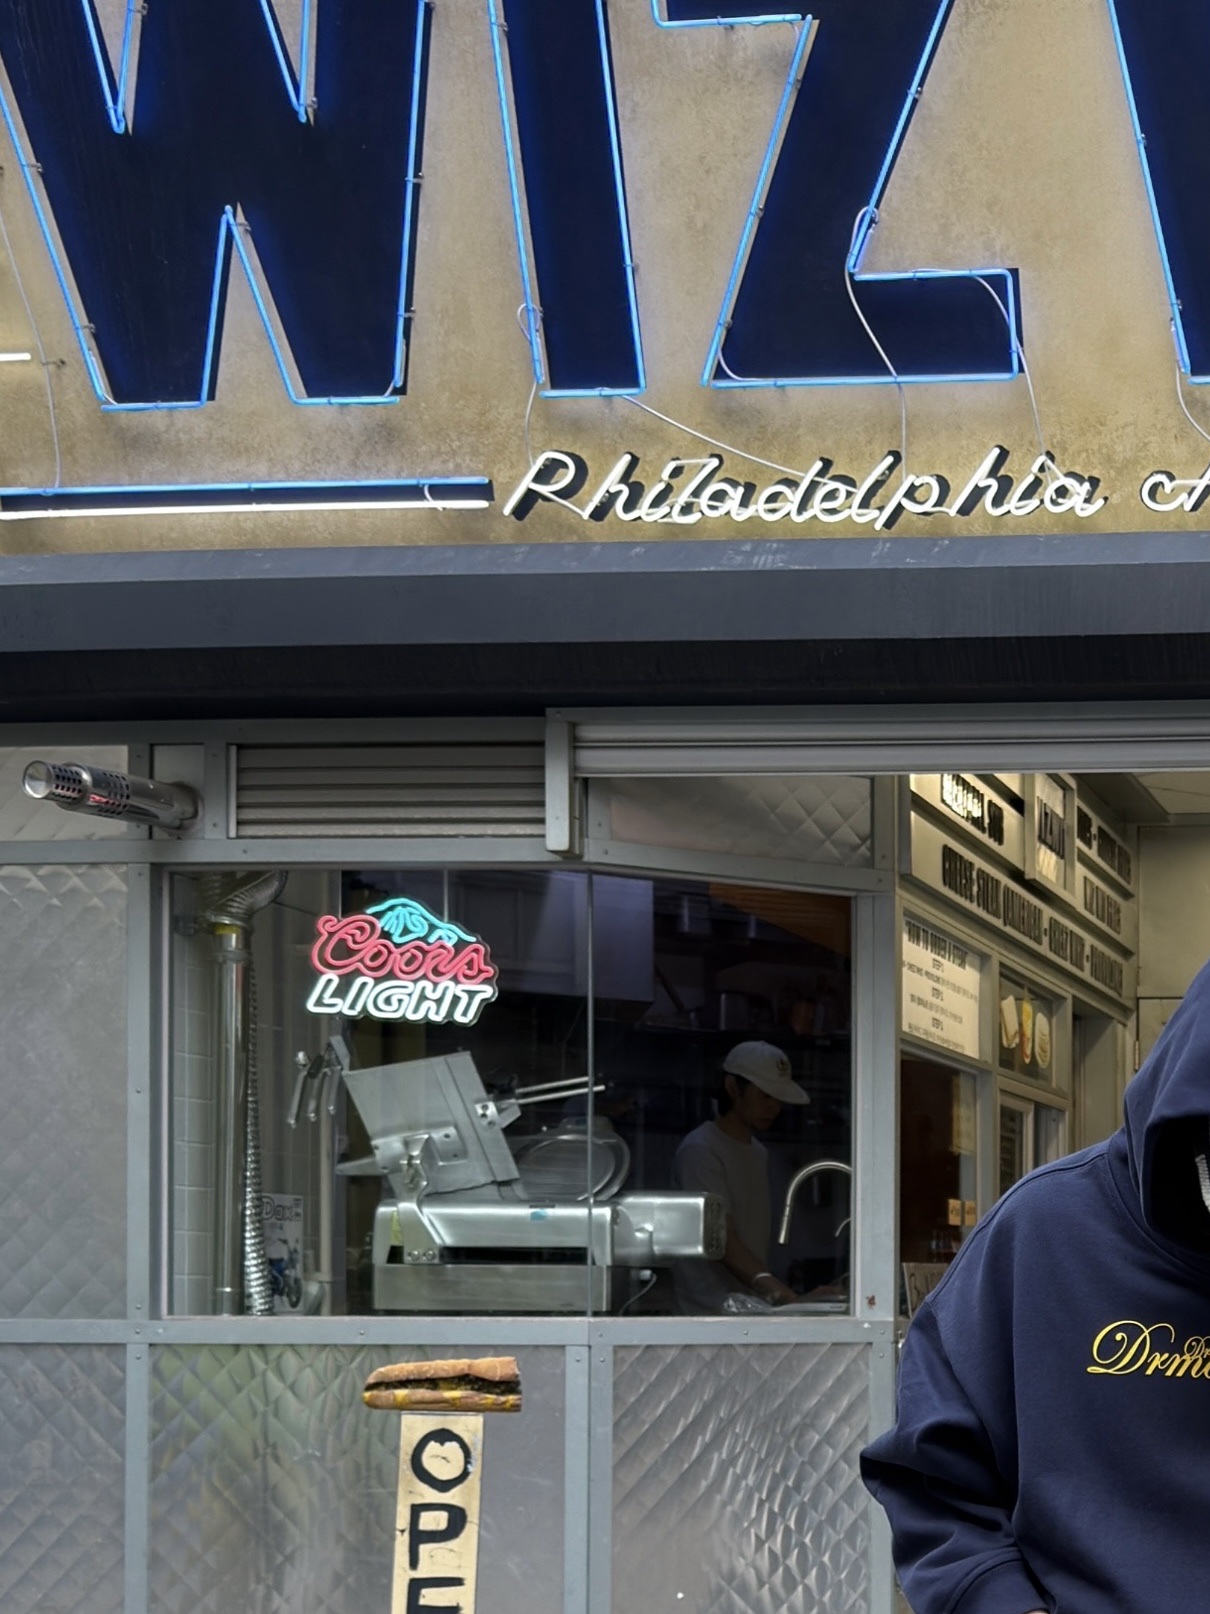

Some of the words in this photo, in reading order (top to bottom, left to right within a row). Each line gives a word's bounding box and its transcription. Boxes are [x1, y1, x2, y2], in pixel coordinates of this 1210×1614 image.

[503, 445, 1107, 531] Philadelphia
[312, 914, 494, 985] Coors
[306, 973, 494, 1024] LIGHT
